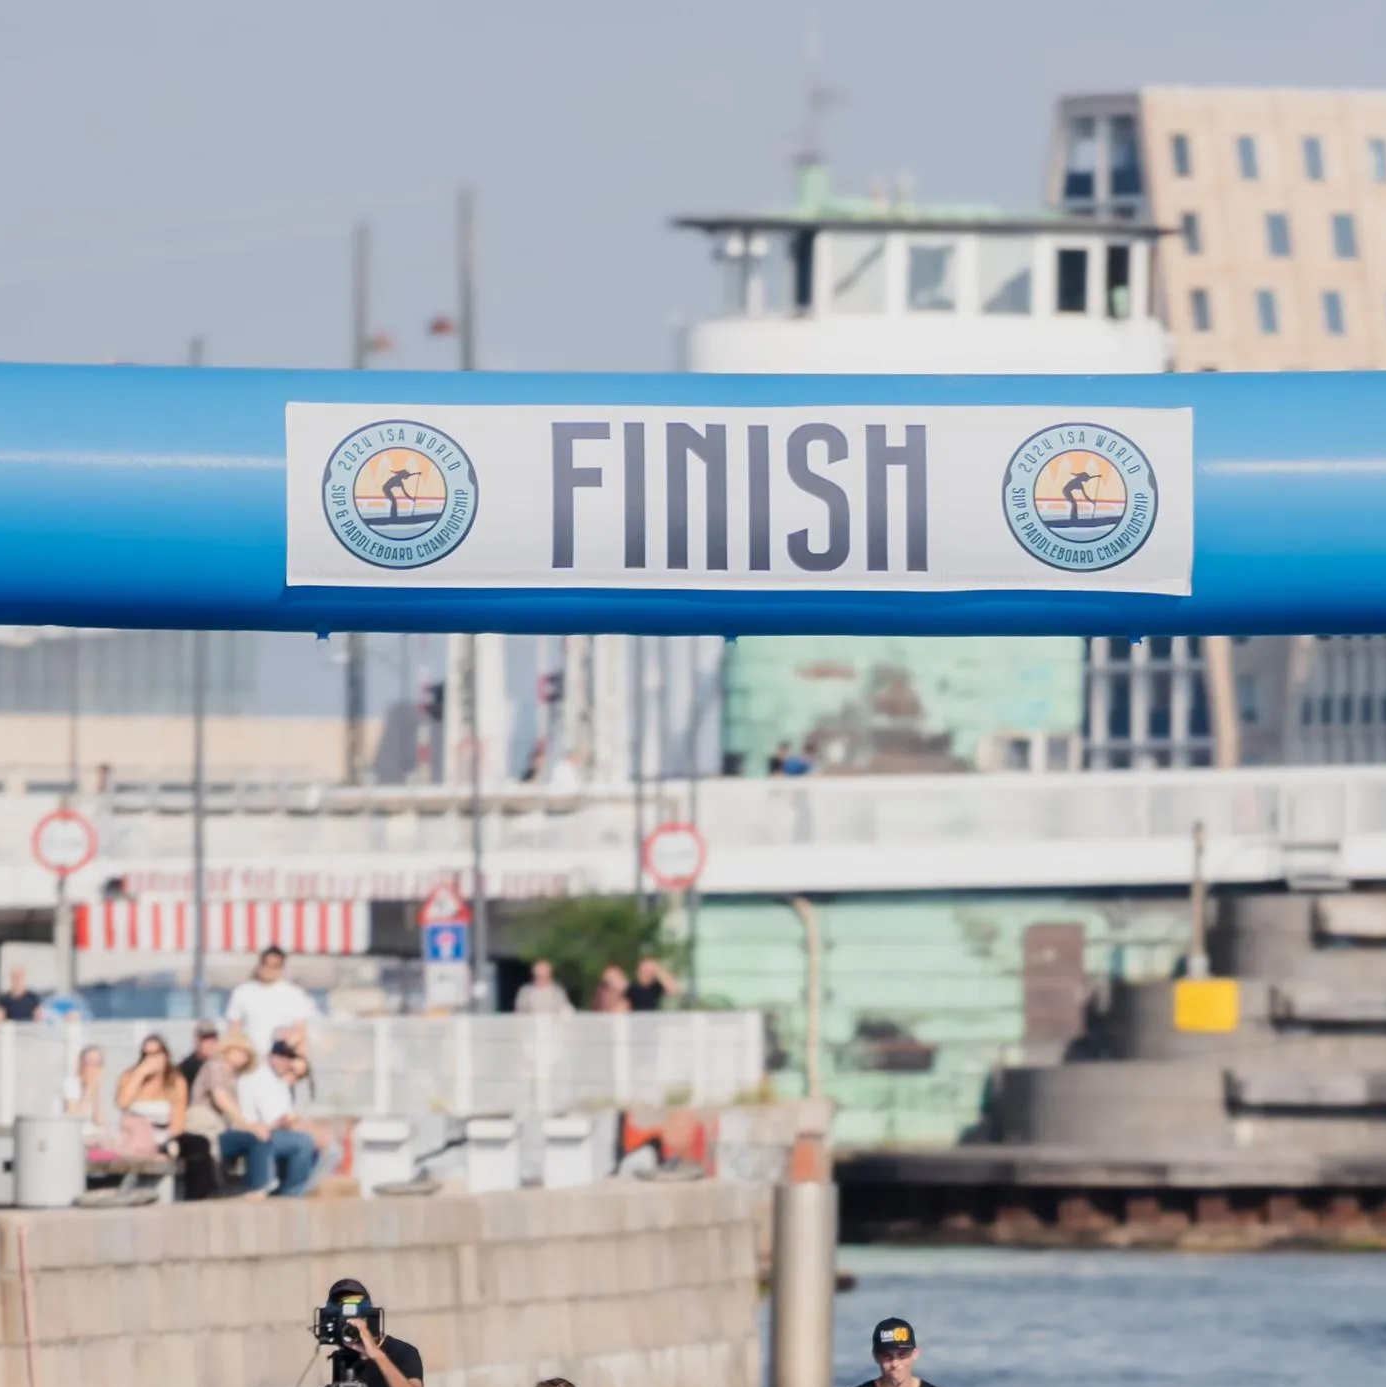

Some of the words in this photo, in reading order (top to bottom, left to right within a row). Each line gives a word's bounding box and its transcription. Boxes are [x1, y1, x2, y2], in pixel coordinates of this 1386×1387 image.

[338, 436, 372, 471] 2024
[379, 429, 405, 442] ISA
[416, 431, 462, 471] WORLD
[1018, 438, 1053, 473] 2024
[1059, 431, 1085, 445] ISA
[1096, 434, 1142, 474] WORLD
[331, 485, 347, 506] SUP
[335, 510, 349, 520] &
[551, 421, 928, 571] FINISH
[1012, 487, 1026, 509] SUP
[417, 489, 469, 558] CHAMPIONSHIP
[1015, 512, 1030, 522] &
[1097, 492, 1149, 561] CHAMPIONSHIP
[341, 520, 413, 560] PADDLEBOARD
[1021, 522, 1094, 564] PADDLEBOARD
